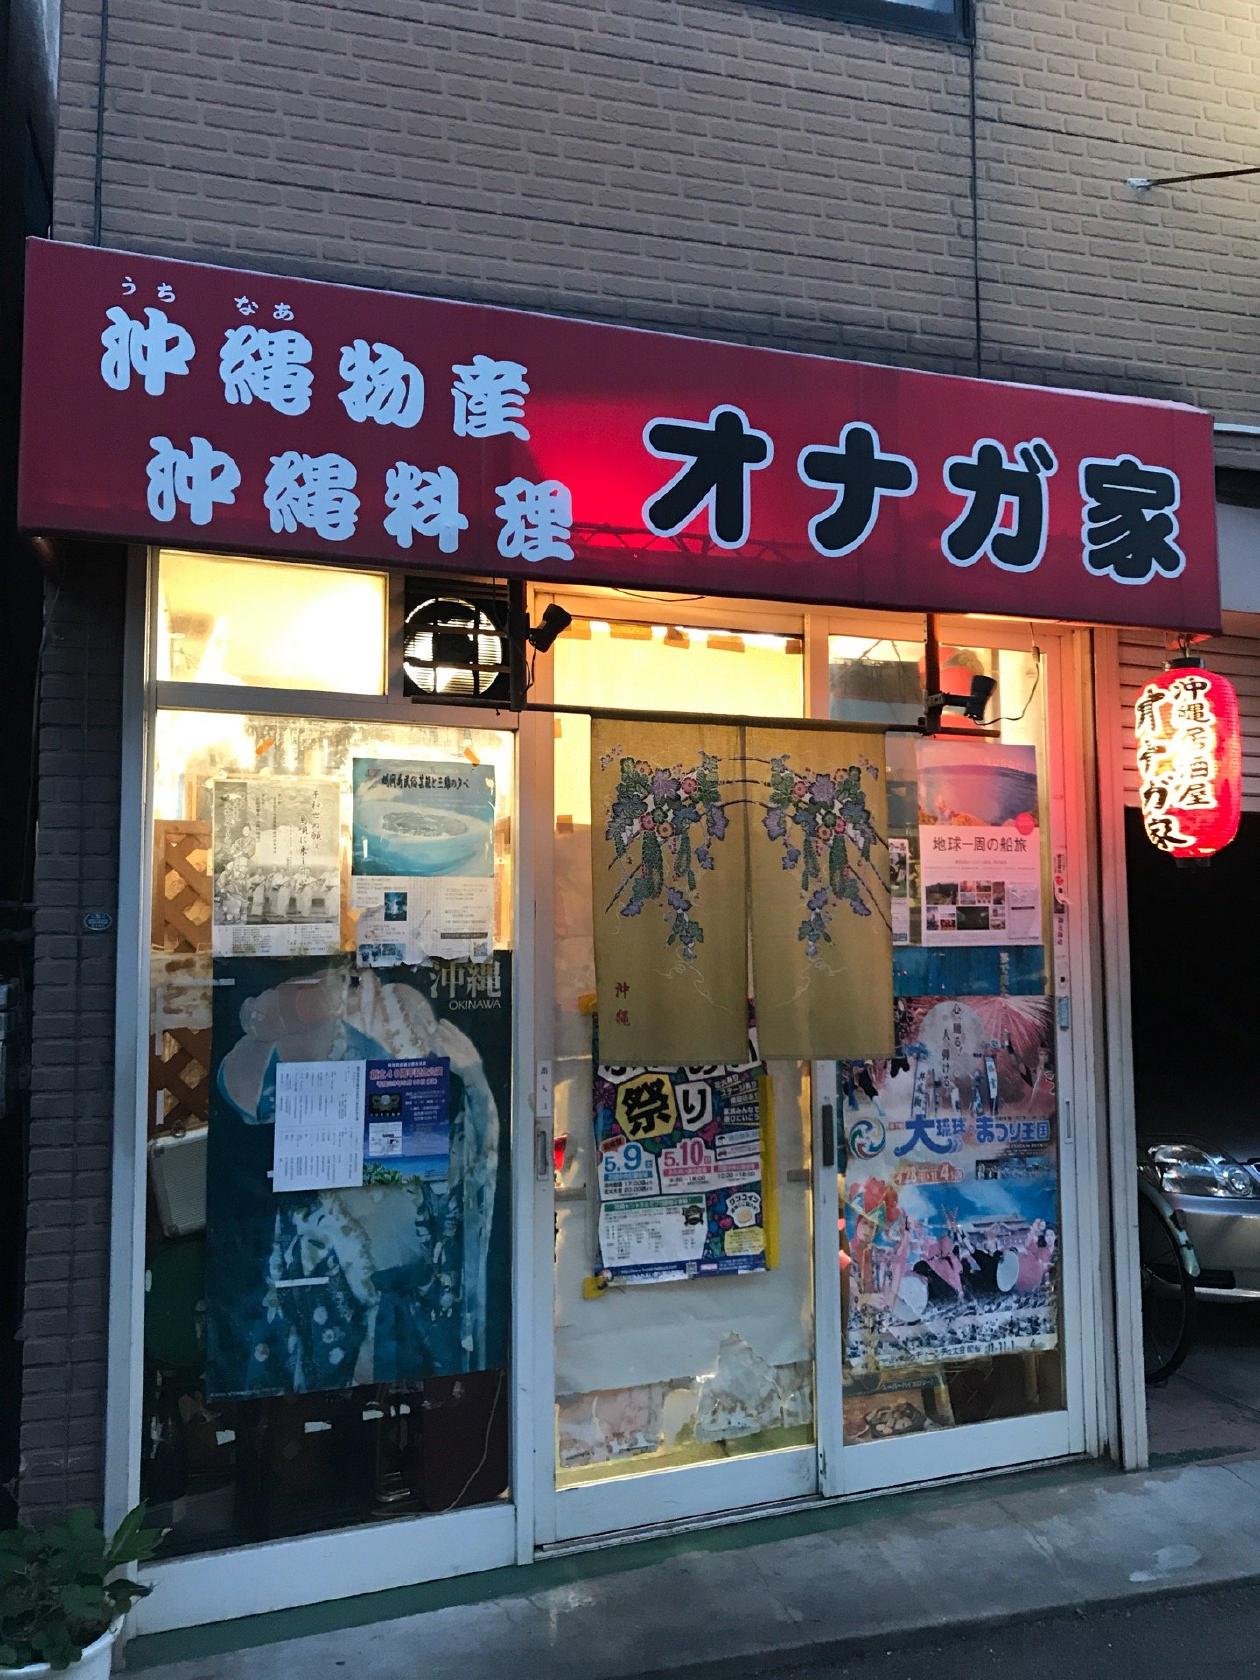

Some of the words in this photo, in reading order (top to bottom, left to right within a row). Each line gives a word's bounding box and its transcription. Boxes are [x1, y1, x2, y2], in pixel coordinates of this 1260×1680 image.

[121, 276, 176, 303] うち
[234, 295, 294, 321] なあ
[101, 305, 530, 441] 沖縄物産
[146, 436, 574, 562] 沖縄料理
[641, 403, 1187, 585] オナガ家
[932, 836, 1028, 853] 地球一周の船旅
[430, 960, 502, 999] 沖縄
[449, 999, 503, 1011] OKINAWA
[621, 1077, 708, 1137] 祭り
[976, 1116, 1050, 1143] まつり王国
[604, 1144, 642, 1172] 5.9
[663, 1140, 704, 1168] 5.10
